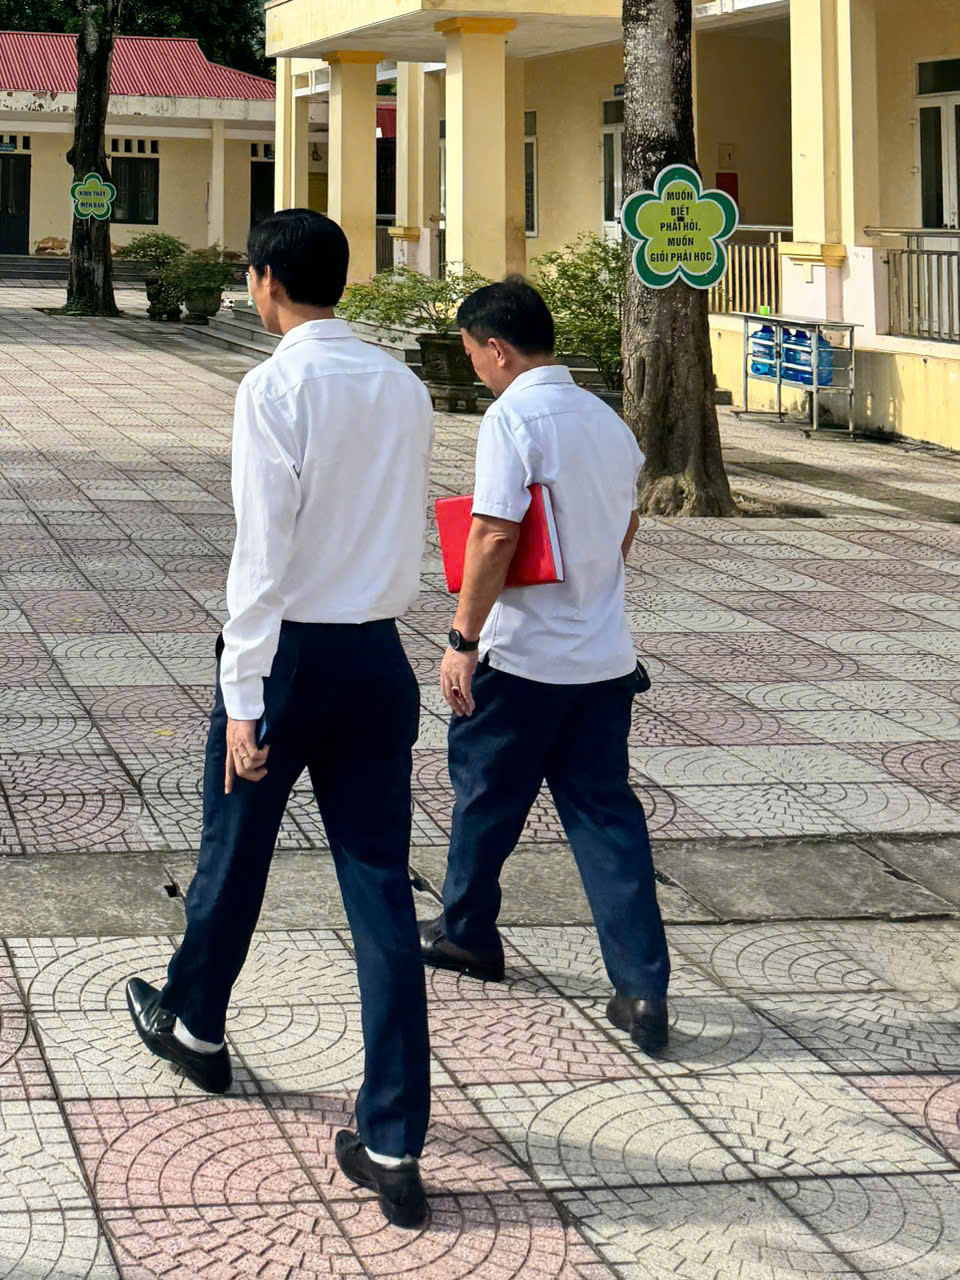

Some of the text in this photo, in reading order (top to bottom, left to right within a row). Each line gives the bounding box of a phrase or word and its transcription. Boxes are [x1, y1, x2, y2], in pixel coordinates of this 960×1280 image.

[667, 188, 693, 200] MUỐN
[671, 204, 689, 216] BIẾT
[660, 218, 701, 232] PHẢI HỎI,
[667, 234, 694, 246] MUỐN
[650, 249, 712, 263] GIỎI PHẢI HỌC
